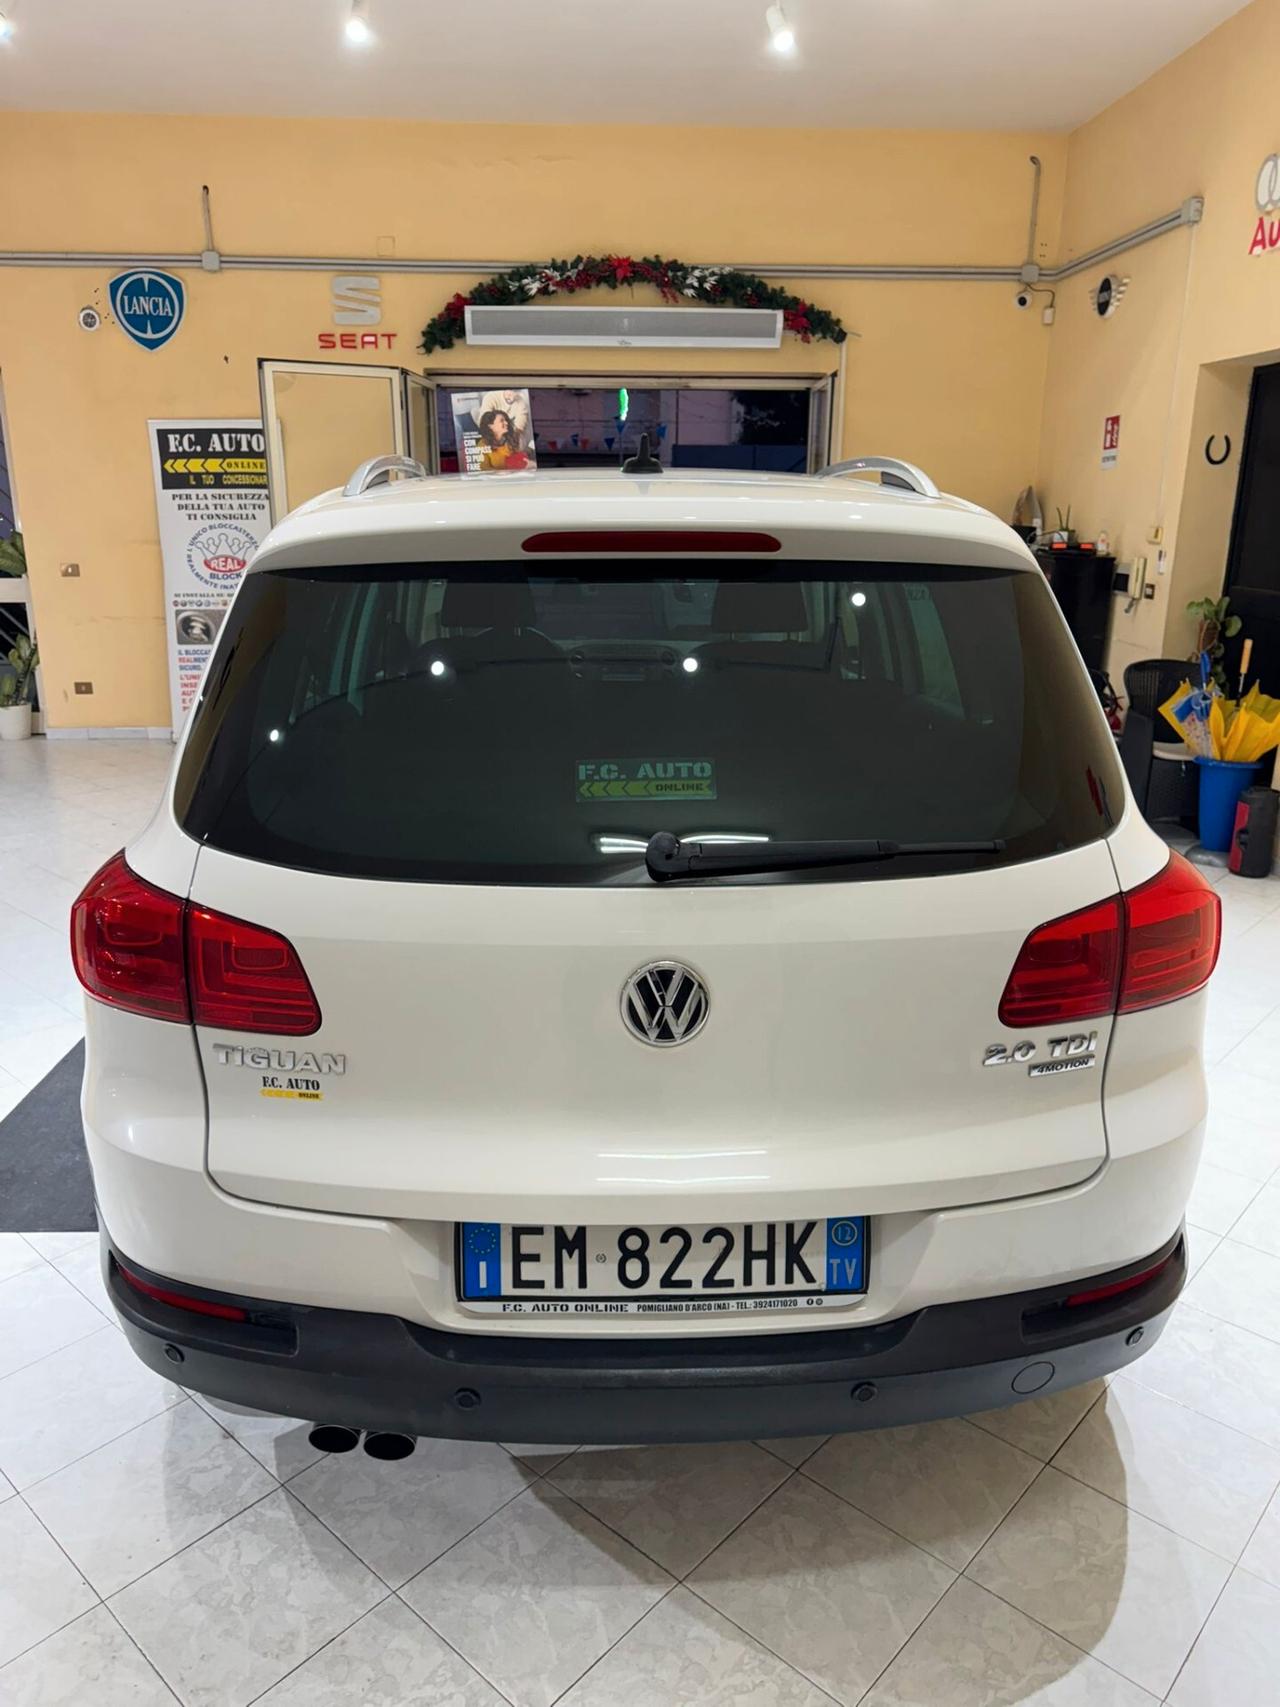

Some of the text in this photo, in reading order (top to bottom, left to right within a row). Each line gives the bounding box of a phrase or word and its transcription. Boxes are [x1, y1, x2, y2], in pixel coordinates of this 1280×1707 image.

[123, 295, 173, 317] LANCIA
[318, 333, 397, 349] SEAT
[167, 433, 265, 452] F.C. AUTO
[226, 461, 266, 469] ONLINE
[172, 493, 269, 501] PER LA SICUREZZA
[177, 503, 265, 511] DELLA TUA AUTO
[186, 513, 257, 521] TI CONSIGLIA
[211, 557, 241, 570] REAL
[209, 572, 242, 581] BLOCK
[578, 762, 712, 780] F.C. AUTO
[655, 783, 704, 791] ONLINE
[212, 1043, 346, 1075] TIGUAN
[983, 1040, 1036, 1066] 2.0
[1037, 1058, 1090, 1074] 4MOTION
[262, 1076, 320, 1091] F.C. AUTO
[512, 1221, 817, 1289] EM 822HK
[829, 1258, 857, 1285] TV
[502, 1303, 526, 1312] F.C.
[531, 1303, 570, 1312] AUTO
[578, 1303, 629, 1312] ONLINE
[637, 1303, 684, 1312] POMIGLIANO
[685, 1303, 713, 1312] D'ARCO
[753, 1299, 798, 1309] 3924171020
